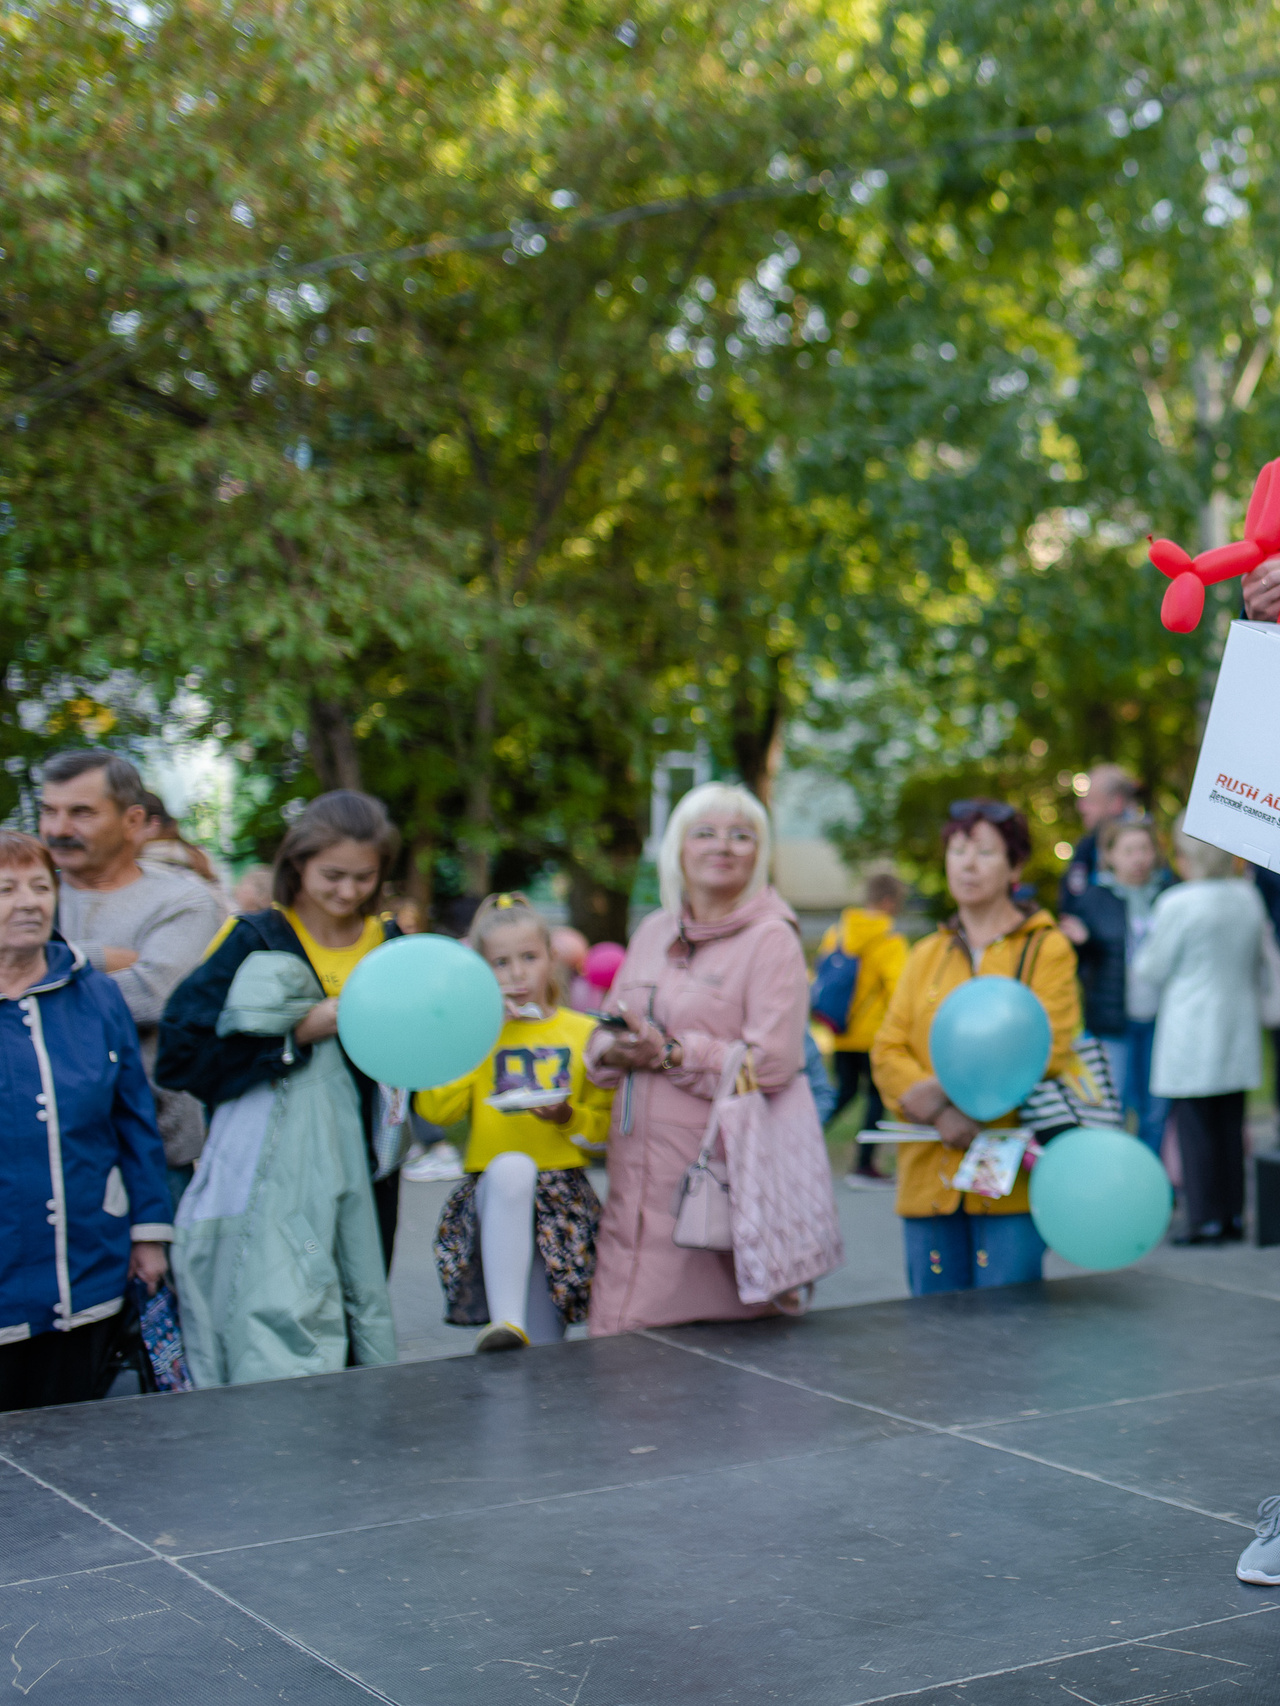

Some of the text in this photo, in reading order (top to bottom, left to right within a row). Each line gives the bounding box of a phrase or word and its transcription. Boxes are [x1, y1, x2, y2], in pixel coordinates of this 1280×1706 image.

[1215, 773, 1260, 800] RUSH
[1209, 790, 1242, 810] Детский
[1243, 805, 1275, 824] самокат
